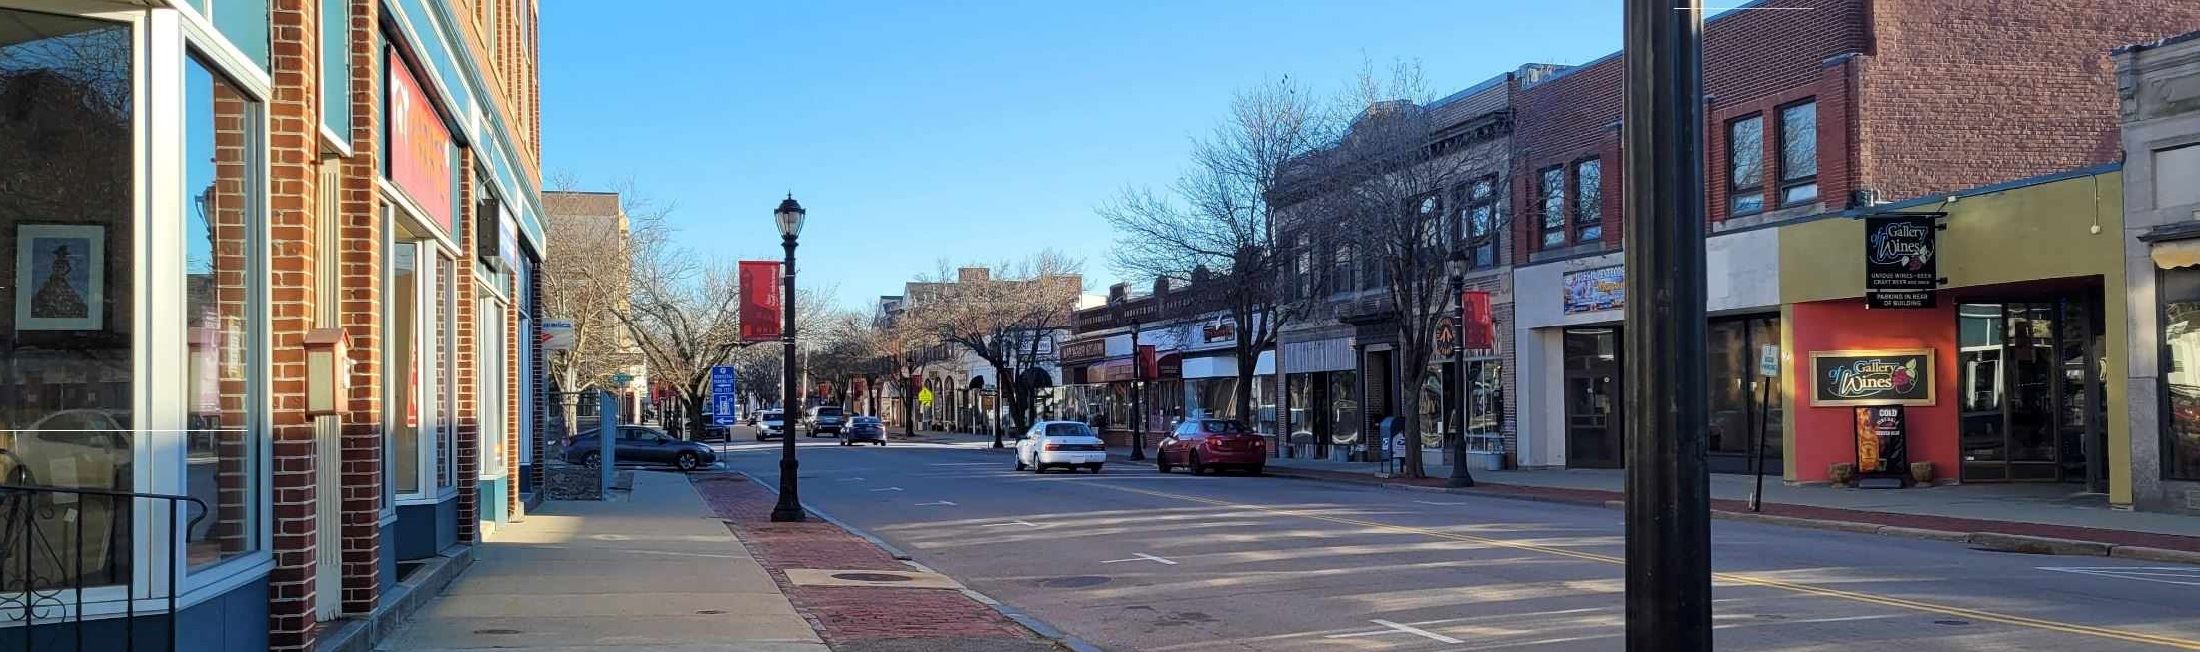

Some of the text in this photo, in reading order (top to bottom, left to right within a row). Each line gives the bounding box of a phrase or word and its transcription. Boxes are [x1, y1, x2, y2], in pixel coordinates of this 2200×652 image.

[1888, 225, 1925, 240] Gallery
[1870, 227, 1920, 258] of Wines
[1855, 362, 1896, 375] Gallery
[1828, 365, 1892, 394] of Wines
[1879, 409, 1898, 417] COLD
